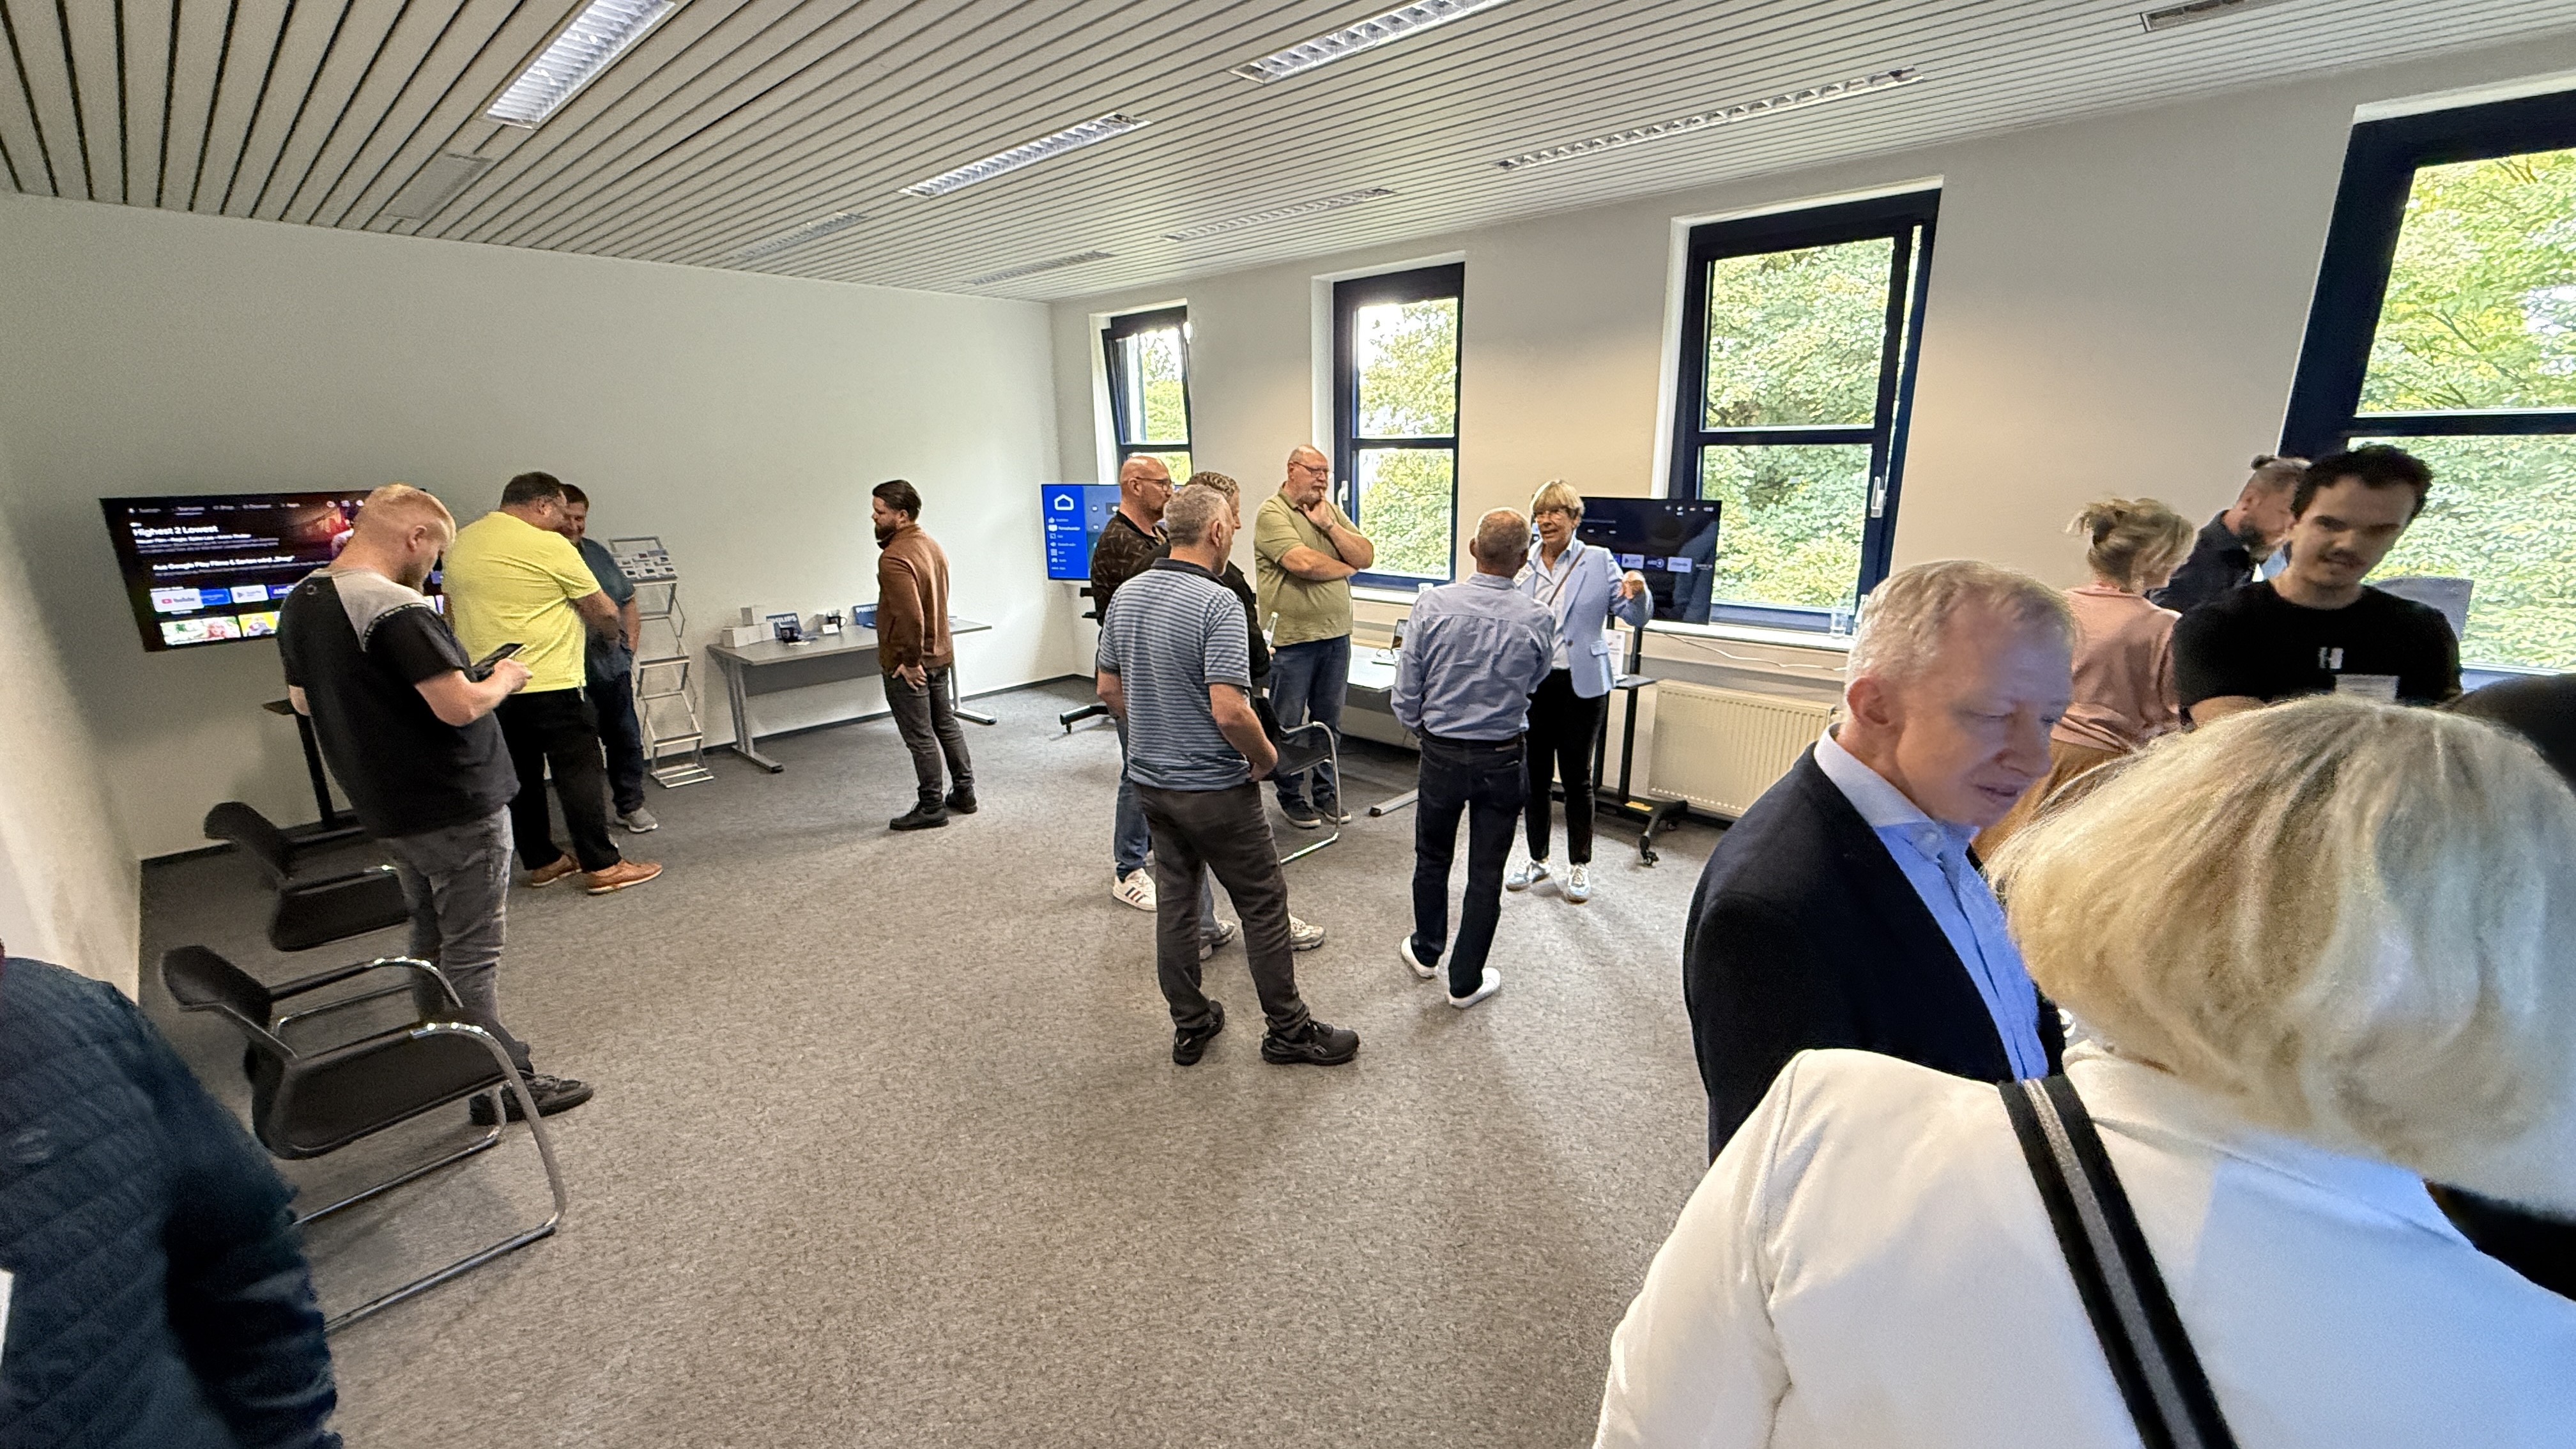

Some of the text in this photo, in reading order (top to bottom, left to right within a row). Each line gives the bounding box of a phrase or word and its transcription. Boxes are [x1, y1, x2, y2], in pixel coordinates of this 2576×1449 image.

[132, 525, 219, 537] Highest 2 Lowest
